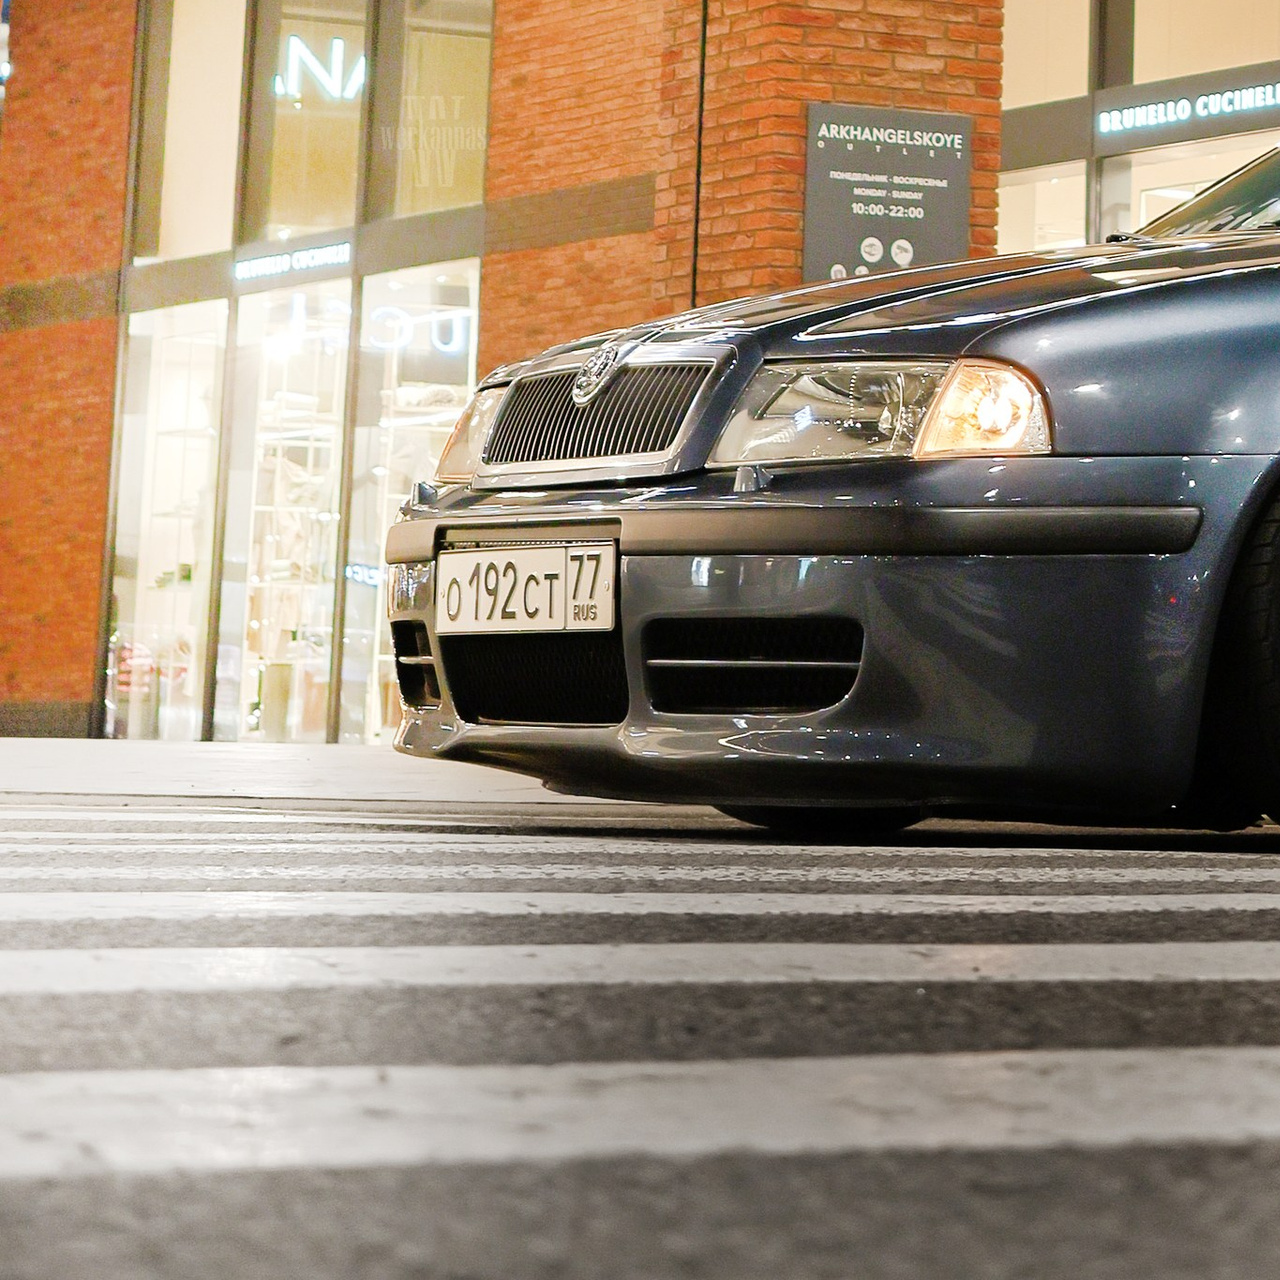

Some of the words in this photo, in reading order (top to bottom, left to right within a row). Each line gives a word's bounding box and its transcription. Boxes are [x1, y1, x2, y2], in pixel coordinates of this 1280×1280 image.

[1098, 97, 1192, 133] BRUNELLO
[817, 122, 963, 149] ARKHANGELSKOYE
[853, 187, 887, 198] MONDAY
[892, 189, 924, 200] SUNDAY
[851, 202, 924, 219] 10:00-22:00
[569, 551, 602, 601] 77
[572, 603, 598, 622] RUS
